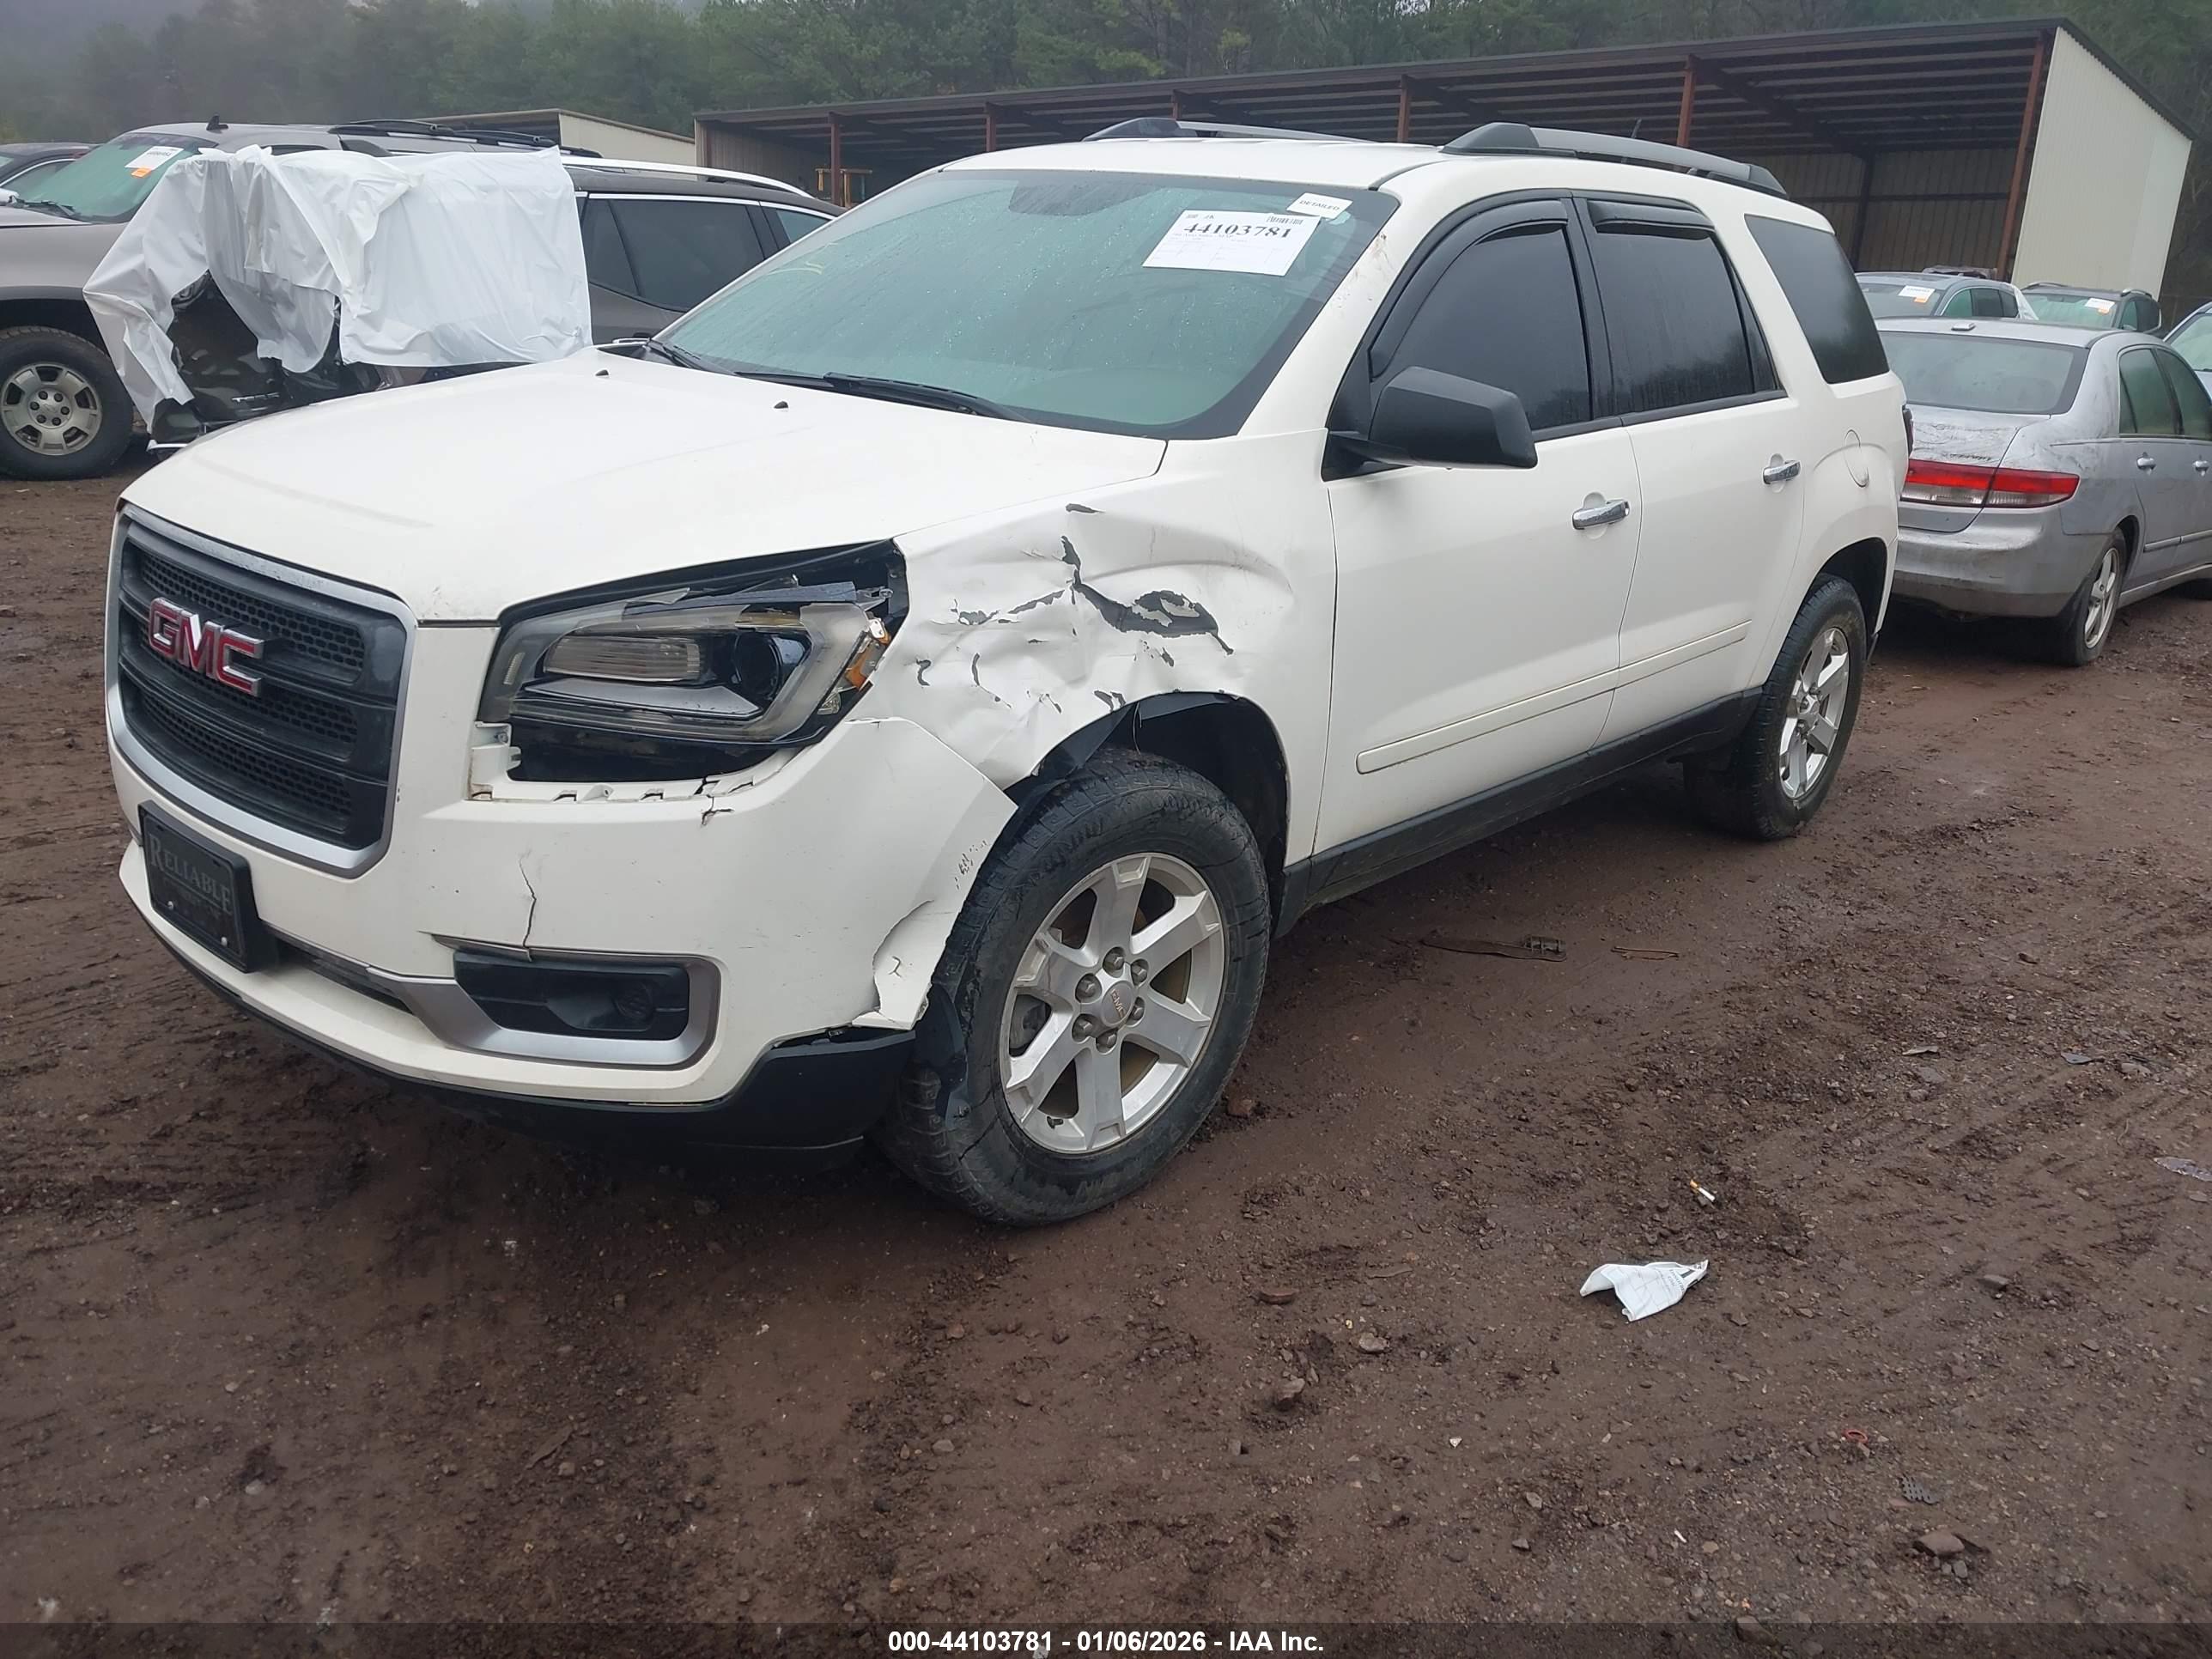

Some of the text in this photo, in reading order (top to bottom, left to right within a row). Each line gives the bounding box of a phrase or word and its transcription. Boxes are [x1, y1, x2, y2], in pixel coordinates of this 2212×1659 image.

[1298, 199, 1340, 211] DETAILED
[1183, 222, 1292, 239] 44103781
[149, 596, 265, 697] GMC
